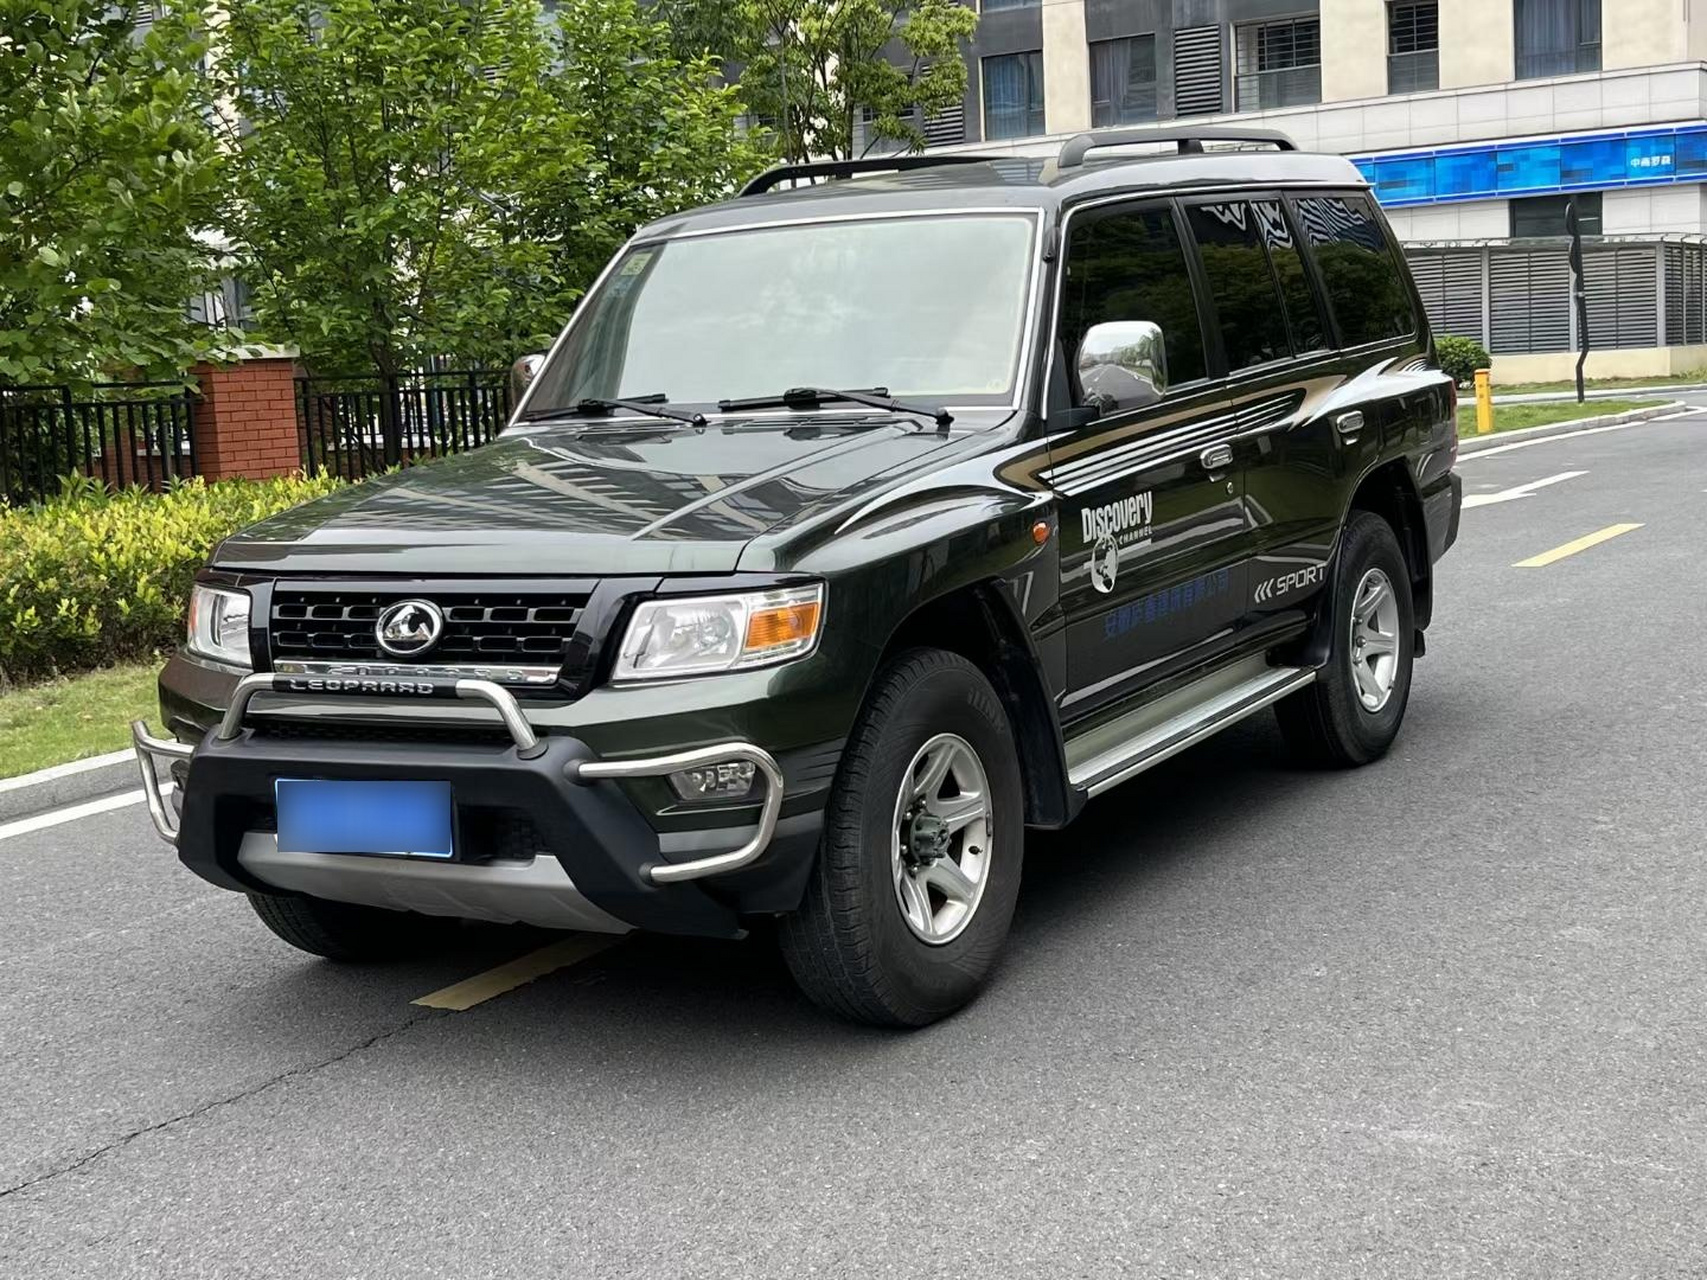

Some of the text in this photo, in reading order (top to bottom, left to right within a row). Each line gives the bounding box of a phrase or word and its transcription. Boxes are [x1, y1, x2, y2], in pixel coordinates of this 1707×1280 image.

[1081, 490, 1153, 543] Discovery
[1118, 526, 1153, 545] CHANNEL
[1276, 562, 1328, 595] SPORT
